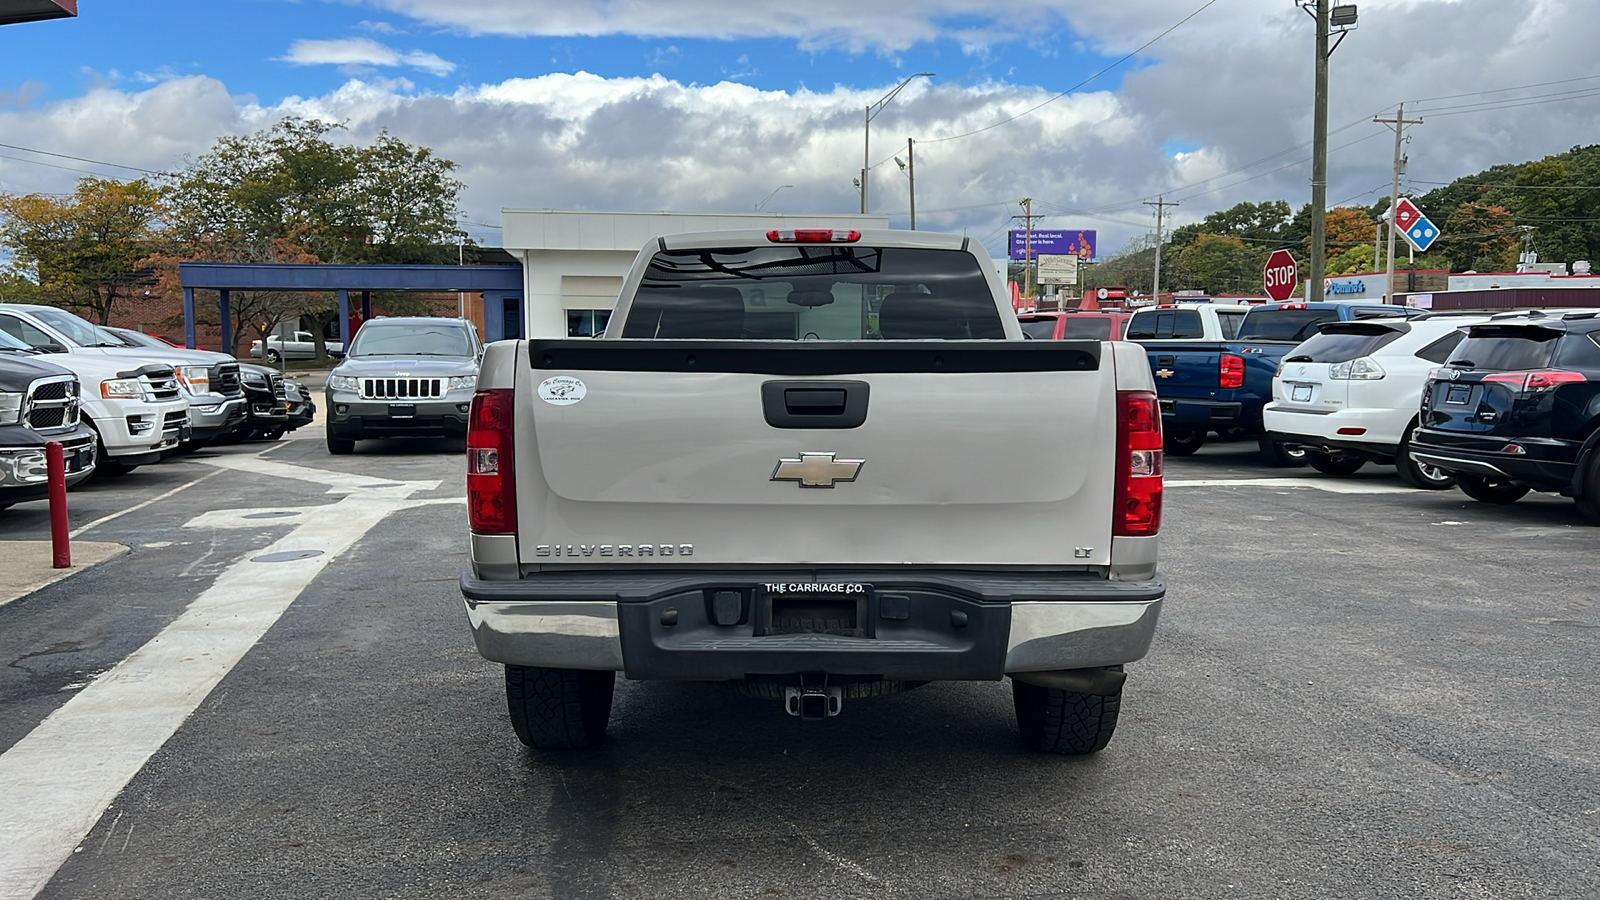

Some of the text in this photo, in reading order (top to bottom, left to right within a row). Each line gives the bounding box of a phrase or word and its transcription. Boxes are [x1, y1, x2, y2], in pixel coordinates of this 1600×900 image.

[1266, 264, 1295, 288] STOP
[1330, 280, 1366, 294] Domino's
[536, 544, 694, 556] SILVERADO
[1075, 547, 1094, 558] LT
[765, 584, 865, 593] THE CARRIAGE CO.
